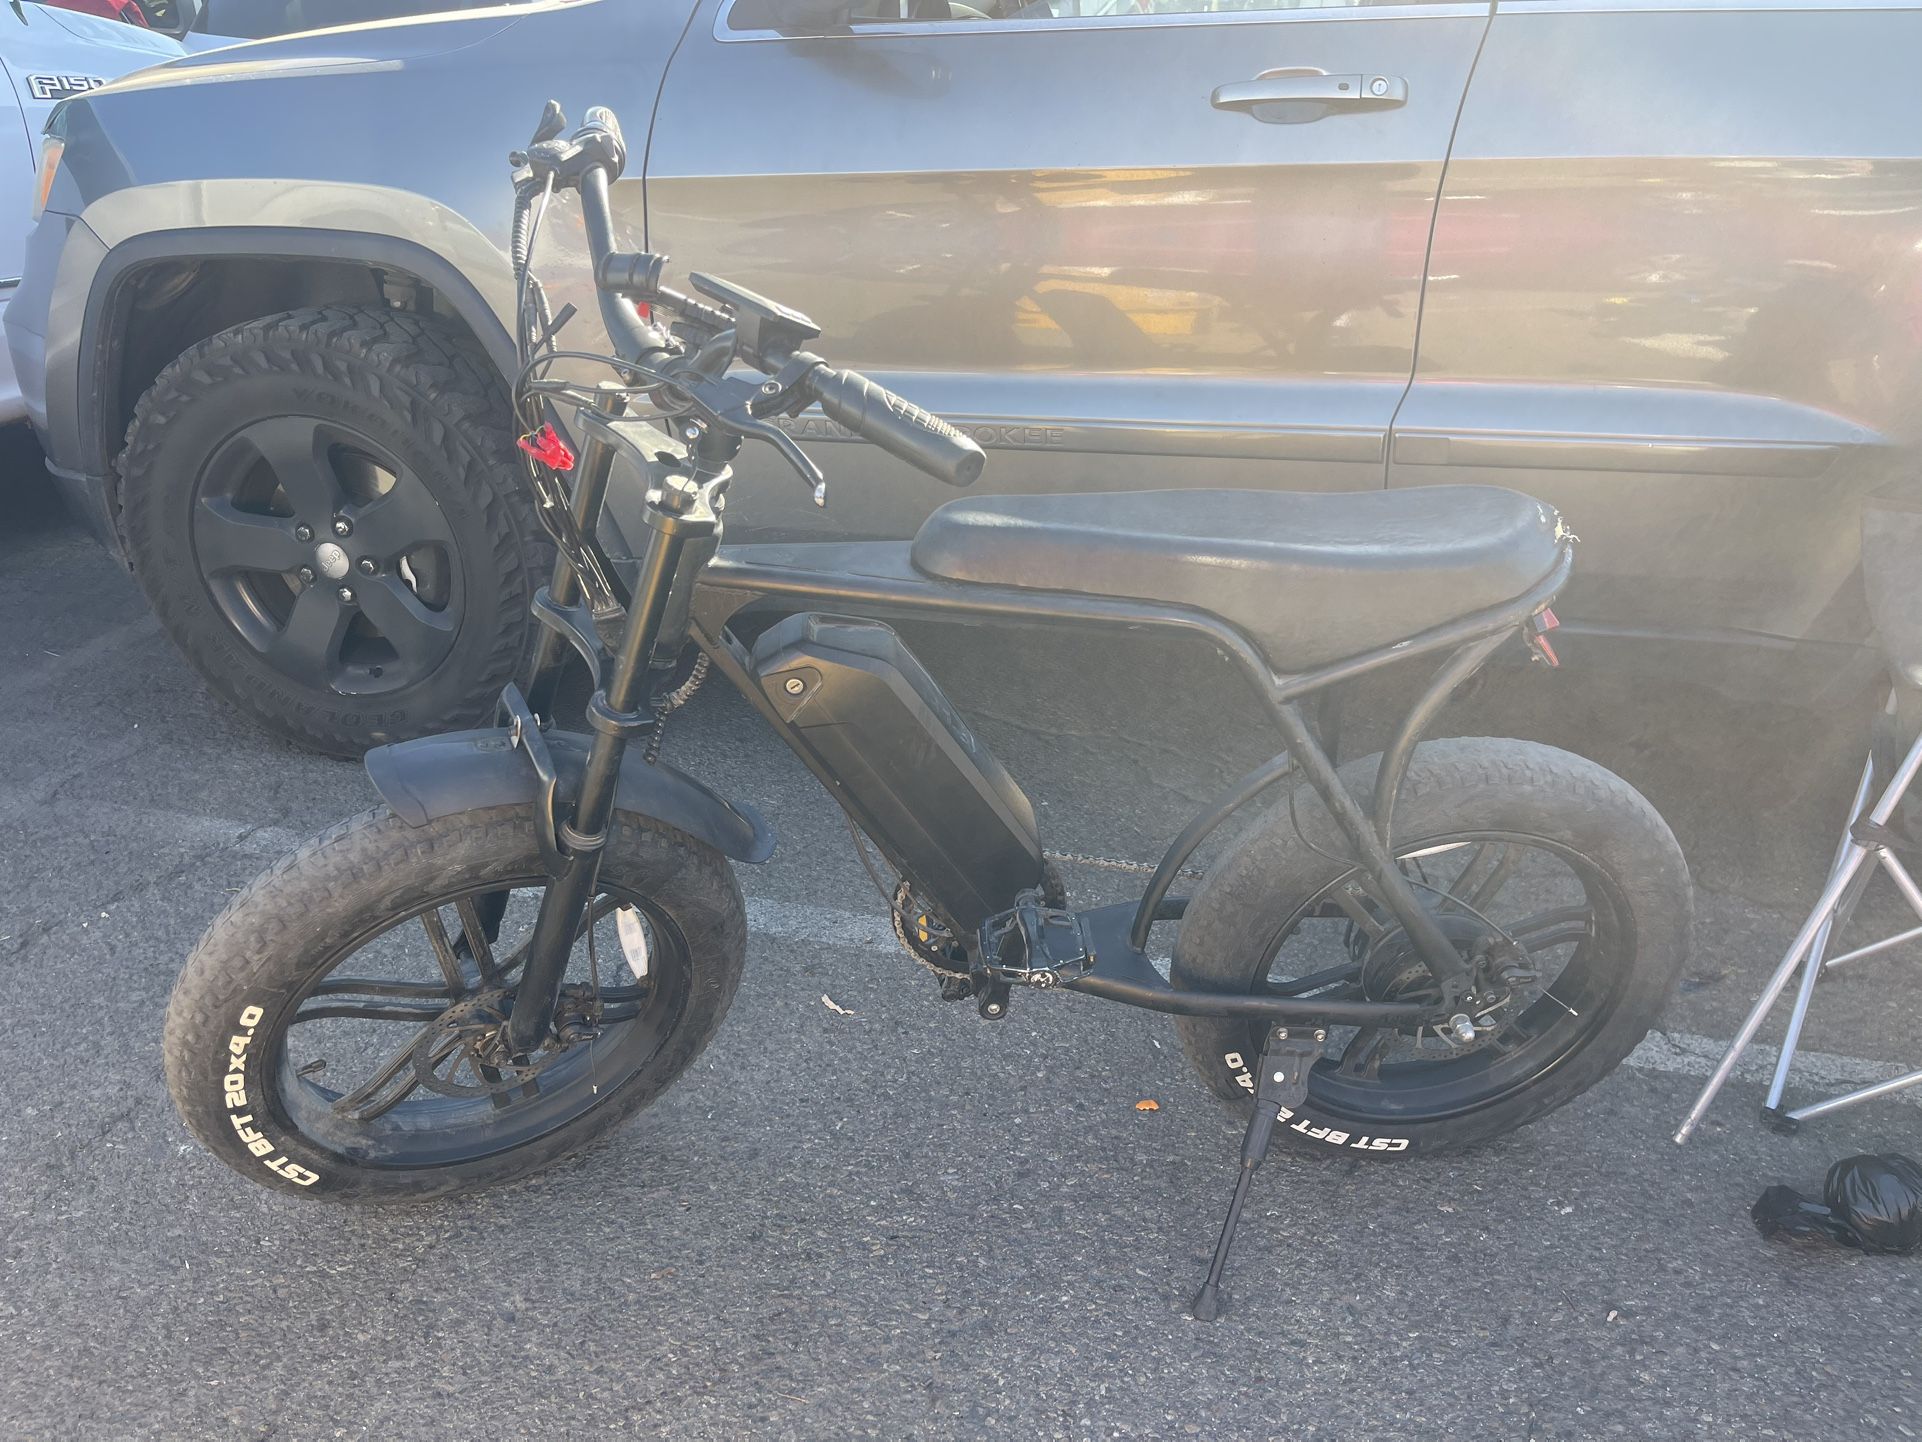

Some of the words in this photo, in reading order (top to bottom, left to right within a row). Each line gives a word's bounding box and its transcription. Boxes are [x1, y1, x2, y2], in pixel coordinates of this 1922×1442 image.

[26, 74, 106, 99] F150
[764, 415, 855, 440] RAN
[321, 549, 341, 572] Jeep
[230, 1114, 275, 1157] BFT
[1290, 1119, 1350, 1145] BFT
[1350, 1136, 1410, 1151] CST
[263, 1156, 320, 1186] CST
